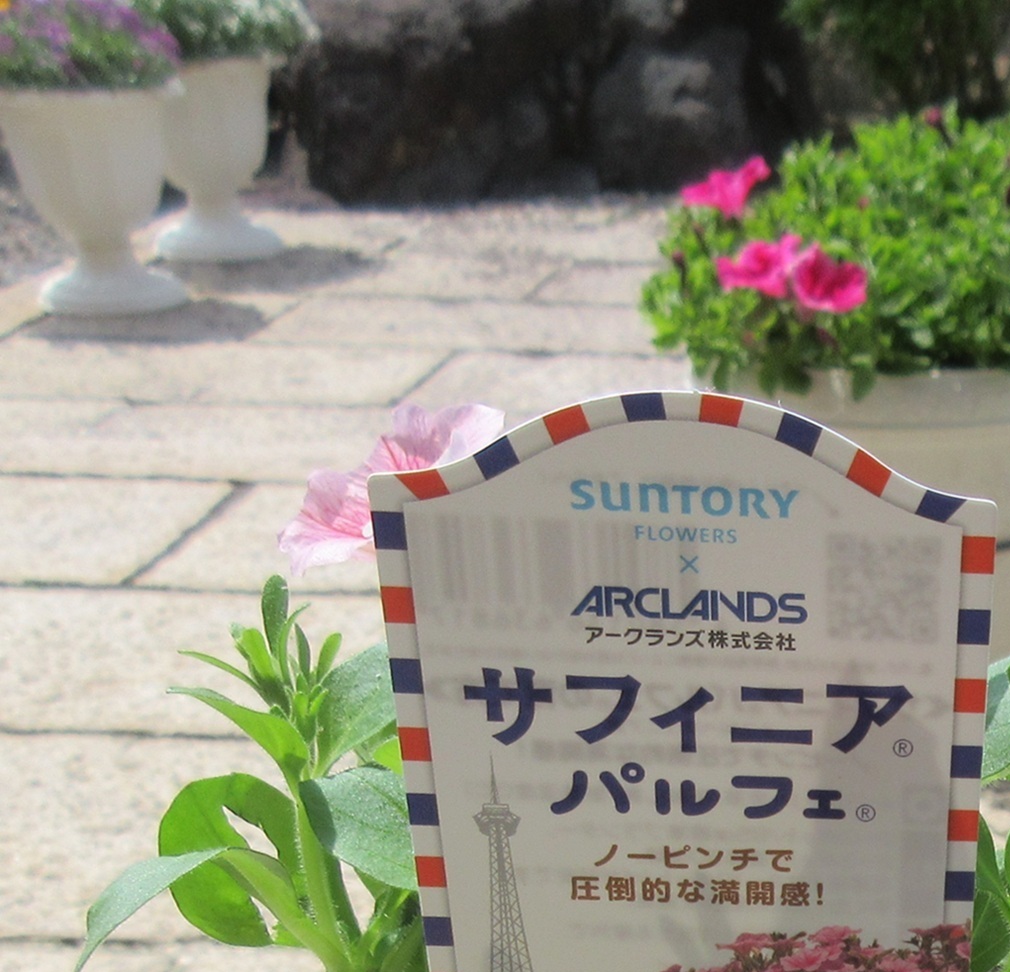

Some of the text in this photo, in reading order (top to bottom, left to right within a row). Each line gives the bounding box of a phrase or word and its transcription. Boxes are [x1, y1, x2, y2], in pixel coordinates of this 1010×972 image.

[634, 524, 738, 545] FLOWERS
[570, 585, 809, 625] ARCLANDS
[584, 627, 797, 651] アークランズ株式会社
[594, 843, 793, 873] ノーピンチで
